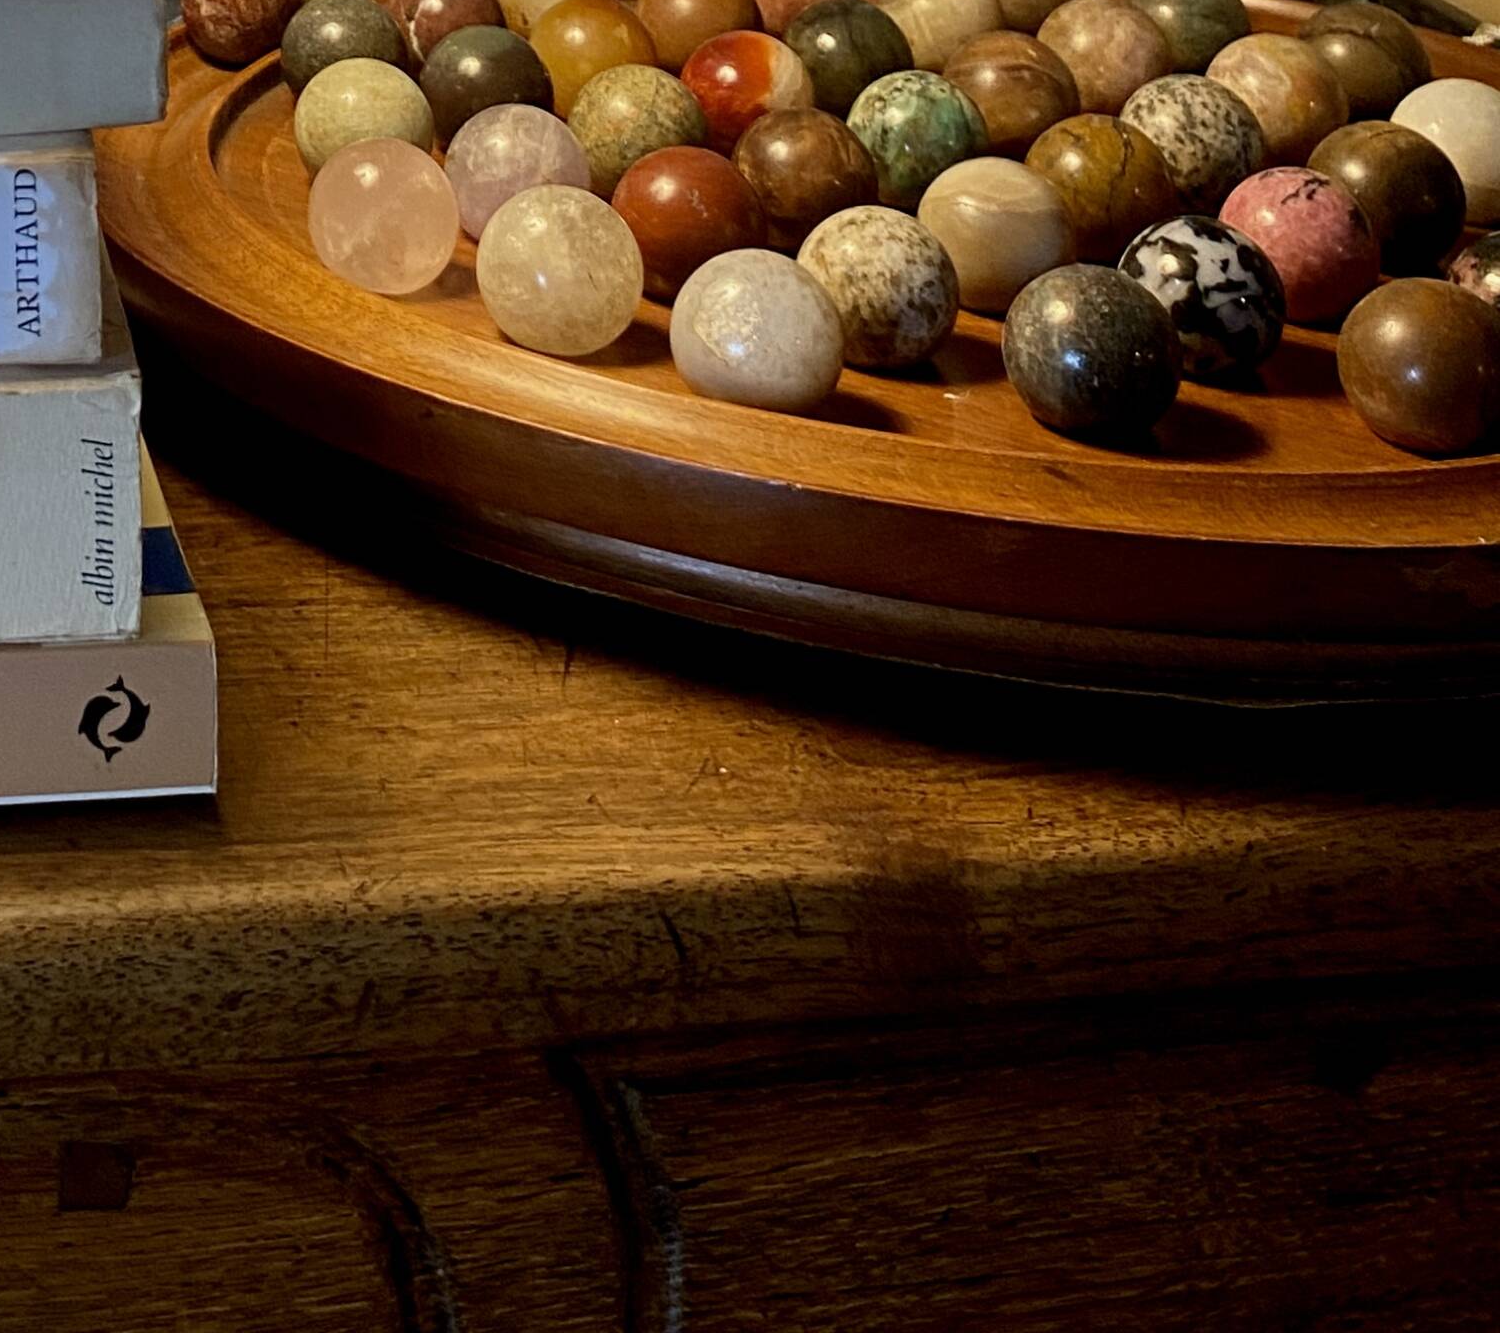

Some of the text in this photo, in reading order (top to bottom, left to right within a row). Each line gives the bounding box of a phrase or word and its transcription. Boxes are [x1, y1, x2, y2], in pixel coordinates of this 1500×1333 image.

[13, 167, 43, 338] ARTHAUD
[81, 438, 115, 607] albin michel
